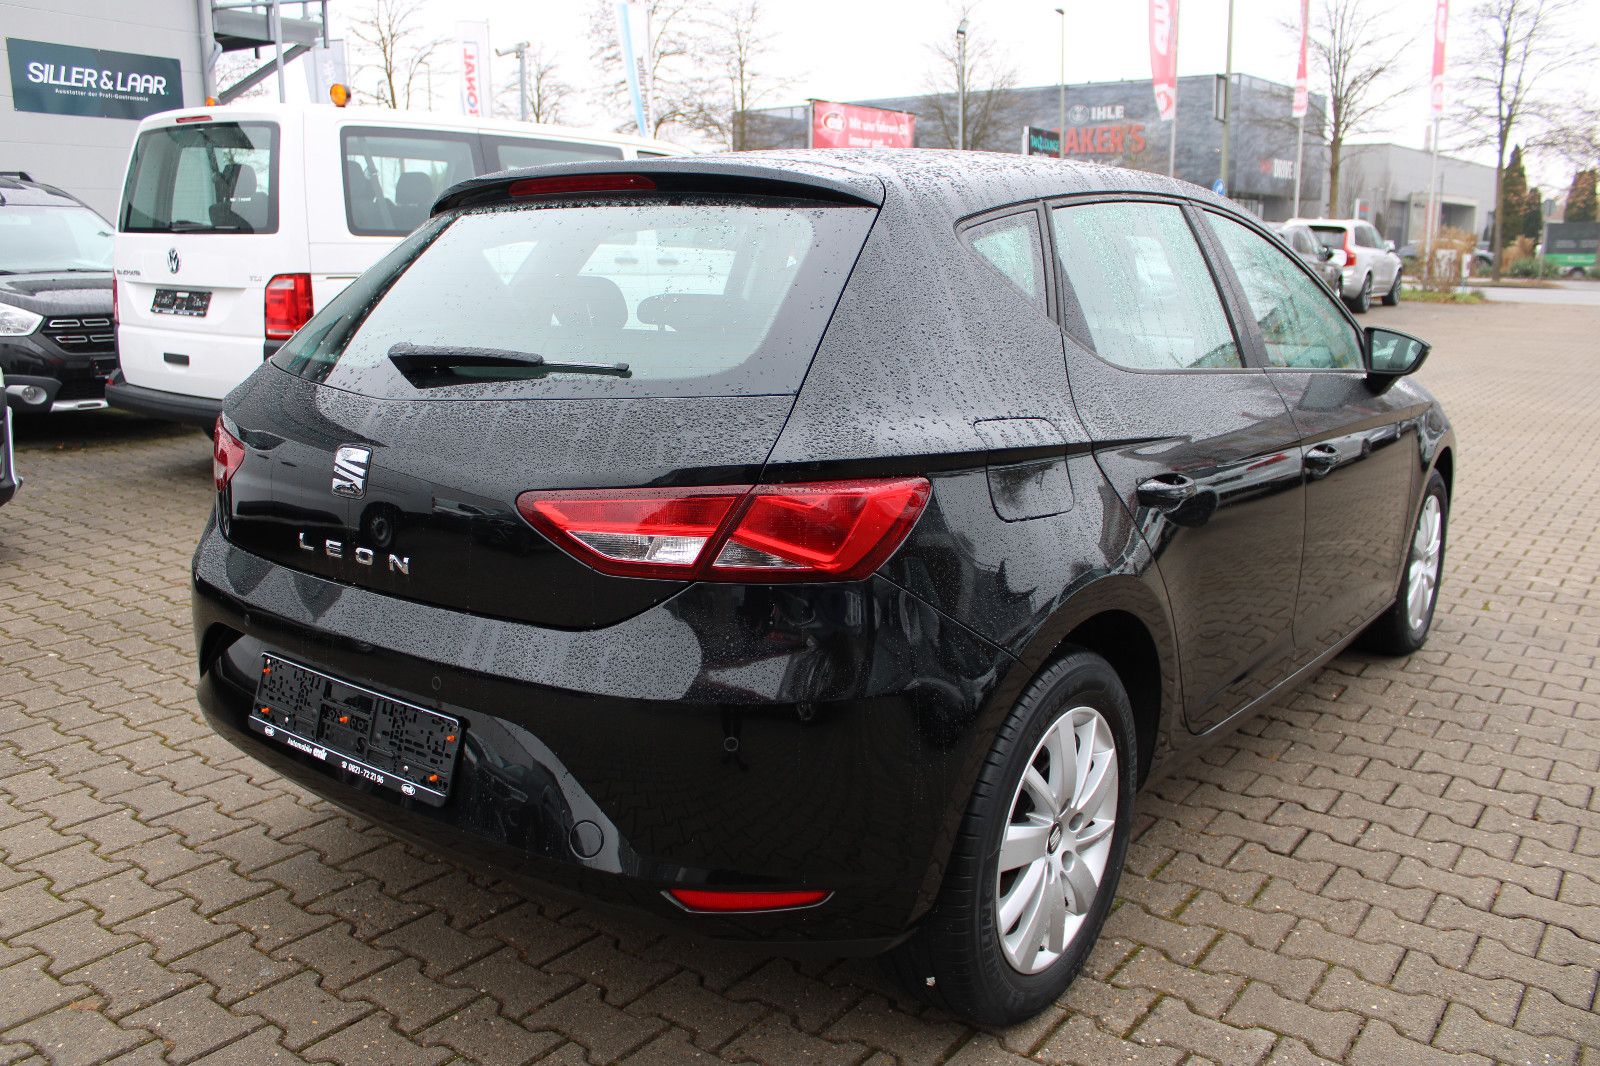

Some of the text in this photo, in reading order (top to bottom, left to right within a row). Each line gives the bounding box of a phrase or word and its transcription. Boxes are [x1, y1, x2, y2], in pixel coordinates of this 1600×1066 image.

[28, 61, 167, 96] SILLER & LAAR
[55, 87, 149, 103] Ausstatter der Profi-Gastronomie
[1091, 104, 1124, 120] IHLE
[1051, 124, 1146, 155] AKER'S
[299, 531, 410, 575] LEON
